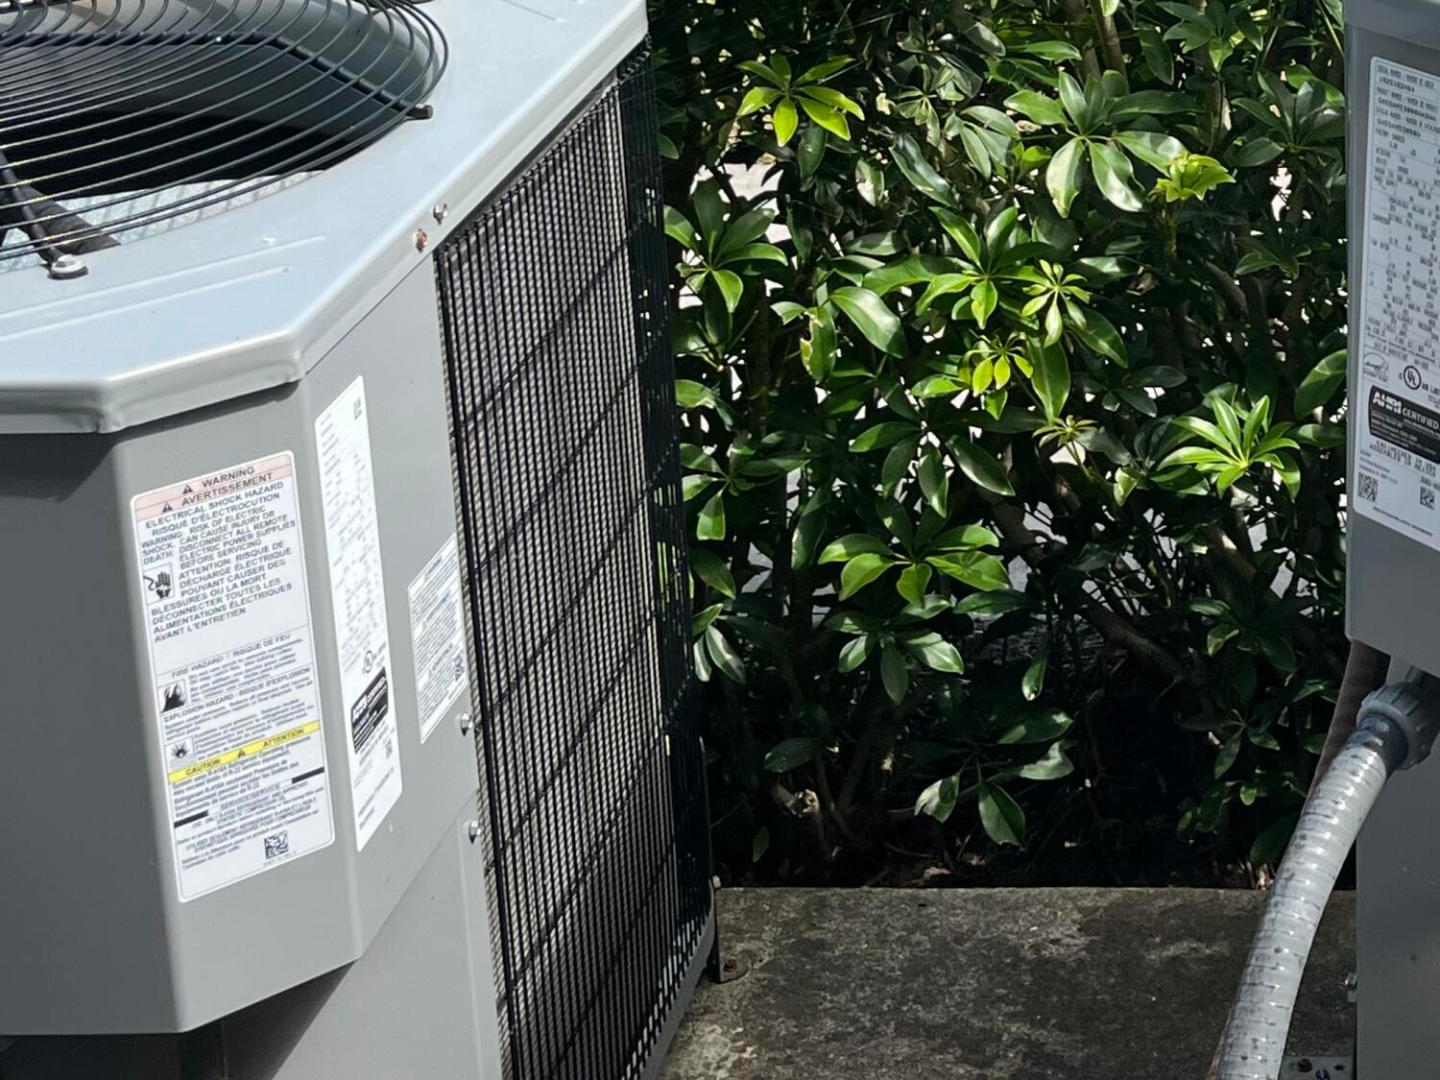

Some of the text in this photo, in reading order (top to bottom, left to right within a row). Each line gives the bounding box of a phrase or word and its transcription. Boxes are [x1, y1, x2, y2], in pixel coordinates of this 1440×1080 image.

[181, 471, 273, 507] AVERTISSEMENT
[202, 465, 255, 488] WARNING
[146, 480, 283, 529] ELECTRICAL SHOCK HAZARD
[189, 522, 209, 534] RISK
[225, 504, 265, 523] ELECTRIC
[152, 519, 188, 537] RISQUE
[179, 533, 198, 545] CAN
[200, 524, 228, 538] CAUSE
[235, 544, 269, 562] RISQUE
[272, 539, 284, 550] DE
[180, 557, 285, 598] POUVANT CAUSER DES
[225, 583, 261, 601] TOUTES
[263, 576, 280, 588] LES
[151, 591, 208, 616] BLESSURES
[209, 586, 223, 597] OU
[225, 581, 238, 592] LA
[153, 603, 226, 635] ALIMENTATIONS
[154, 626, 184, 643] AVANT
[185, 726, 304, 776] CAUTION ATTENTION
